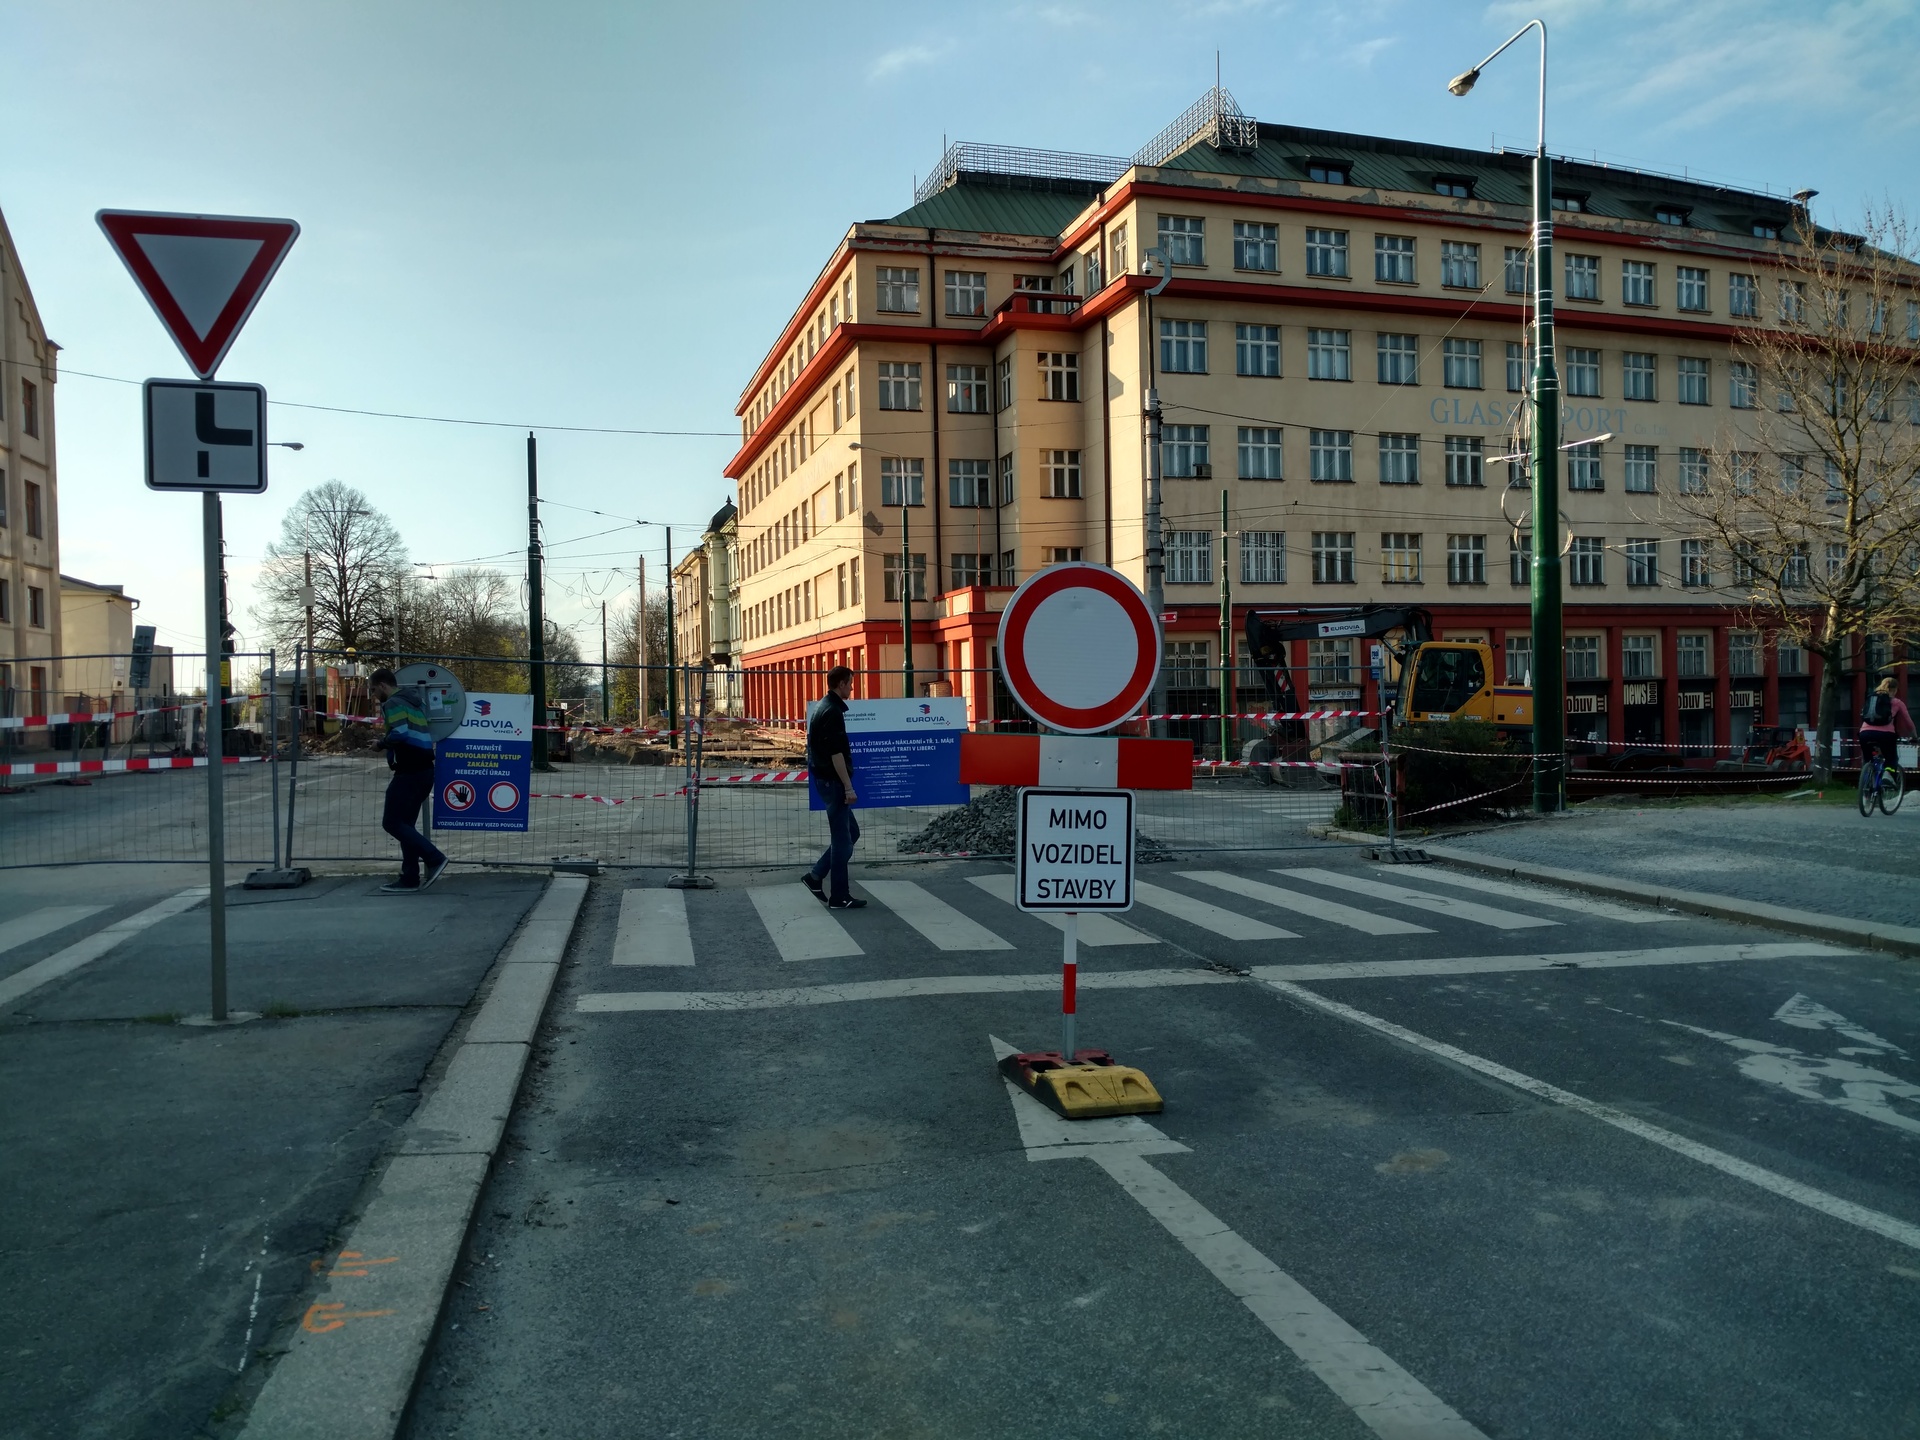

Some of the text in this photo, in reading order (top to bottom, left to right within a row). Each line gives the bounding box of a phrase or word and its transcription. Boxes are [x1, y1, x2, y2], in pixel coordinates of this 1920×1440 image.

[1430, 397, 1628, 434] GLASSPORT
[1623, 683, 1647, 705] news
[1648, 682, 1657, 704] boom
[1566, 695, 1593, 713] obuv
[460, 719, 514, 729] UROVIA
[868, 739, 892, 747] ŽITAVSKÁ
[895, 738, 923, 746] NÁKLADNÍ
[465, 744, 503, 752] STAVENIŠTĚ
[863, 745, 896, 753] TRAMVAJOVÉ
[445, 751, 499, 760] NEPOVOLANÝM
[466, 760, 499, 768] ZAKÁZÁN
[454, 767, 511, 777] NEBEZPEČÍ ÚRAZU
[437, 820, 464, 828] VOZIDLŮM
[1049, 808, 1107, 830] MIMO
[1031, 843, 1122, 865] VOZIDEL
[1036, 878, 1117, 900] STAVBY
